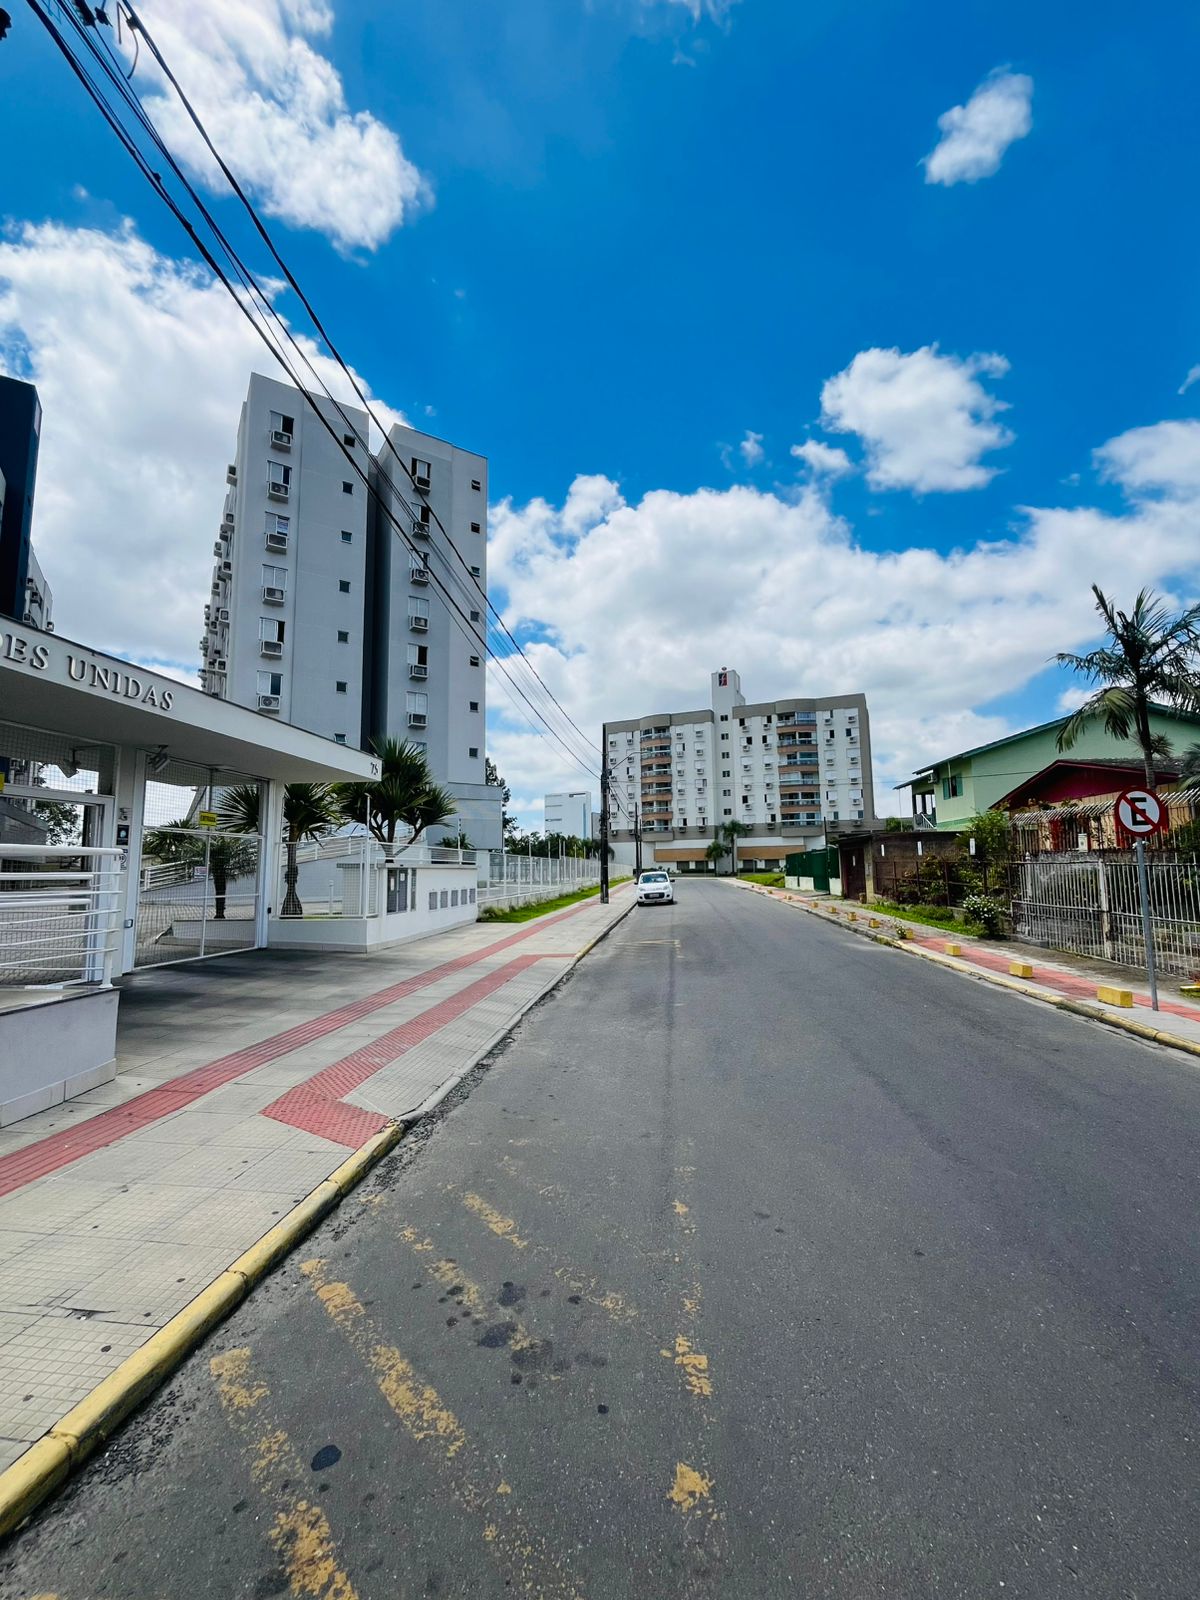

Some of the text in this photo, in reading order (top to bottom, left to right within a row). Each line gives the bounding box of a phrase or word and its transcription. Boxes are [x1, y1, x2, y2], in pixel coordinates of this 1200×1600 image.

[0, 632, 175, 711] ES UNIDAS
[1129, 796, 1154, 826] E
